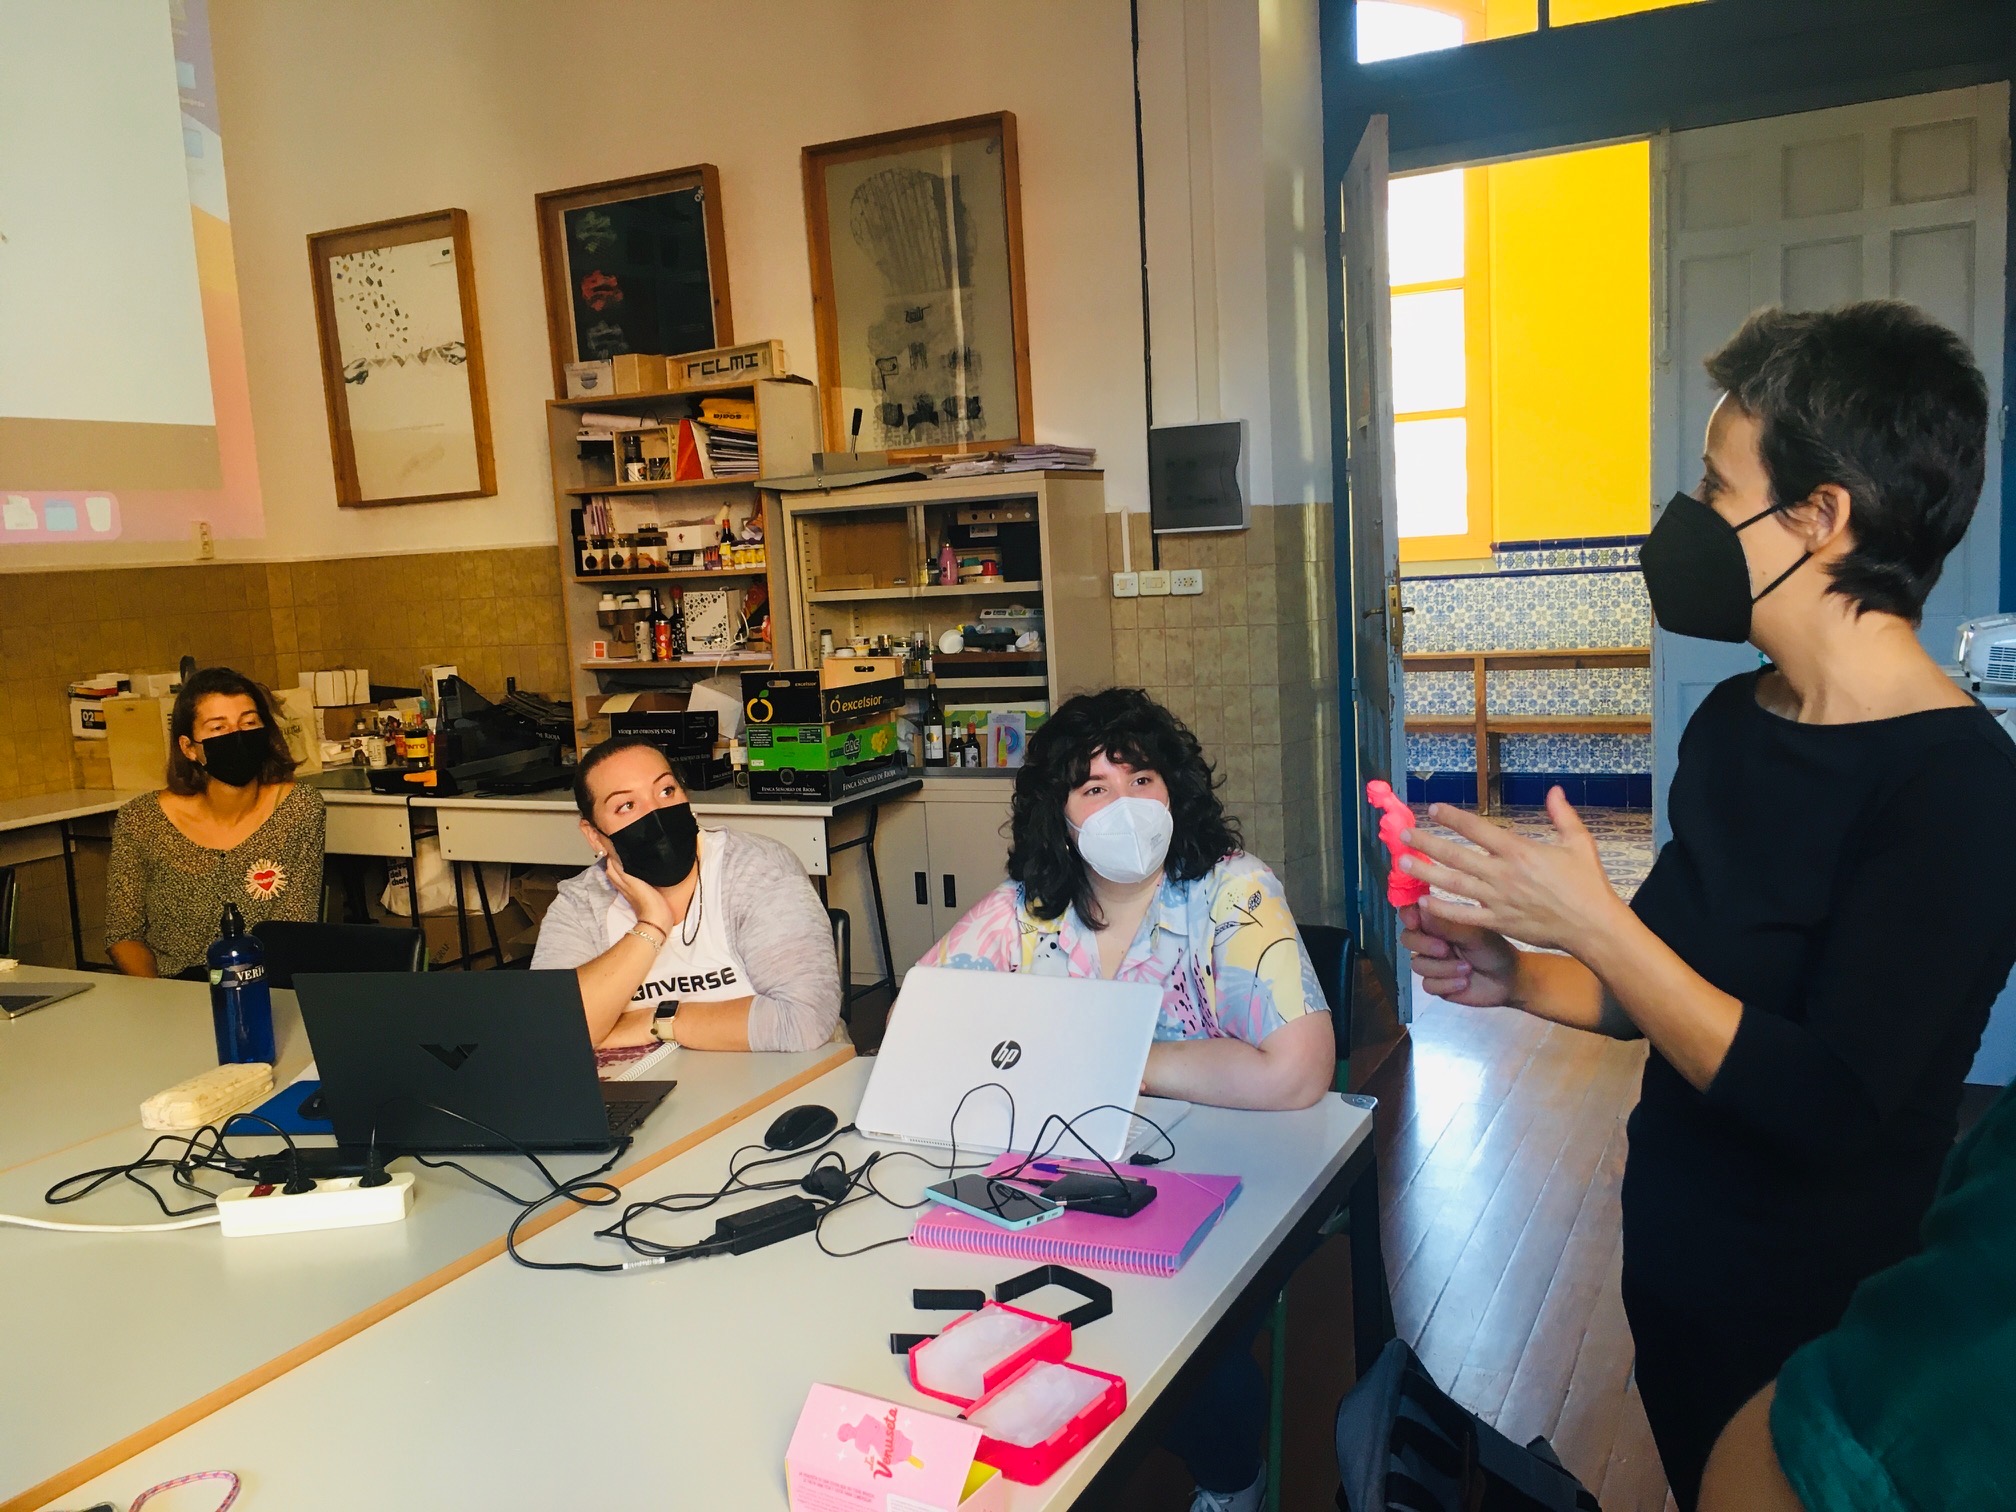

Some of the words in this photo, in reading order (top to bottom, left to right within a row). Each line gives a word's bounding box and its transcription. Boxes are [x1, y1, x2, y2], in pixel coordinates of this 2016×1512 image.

[842, 694, 882, 712] excelsior
[82, 711, 95, 722] 02
[842, 782, 857, 791] FINCA
[876, 772, 884, 781] DE
[883, 769, 897, 778] RIOJA
[631, 967, 737, 1002] ONVERSE
[992, 1040, 1021, 1070] hp
